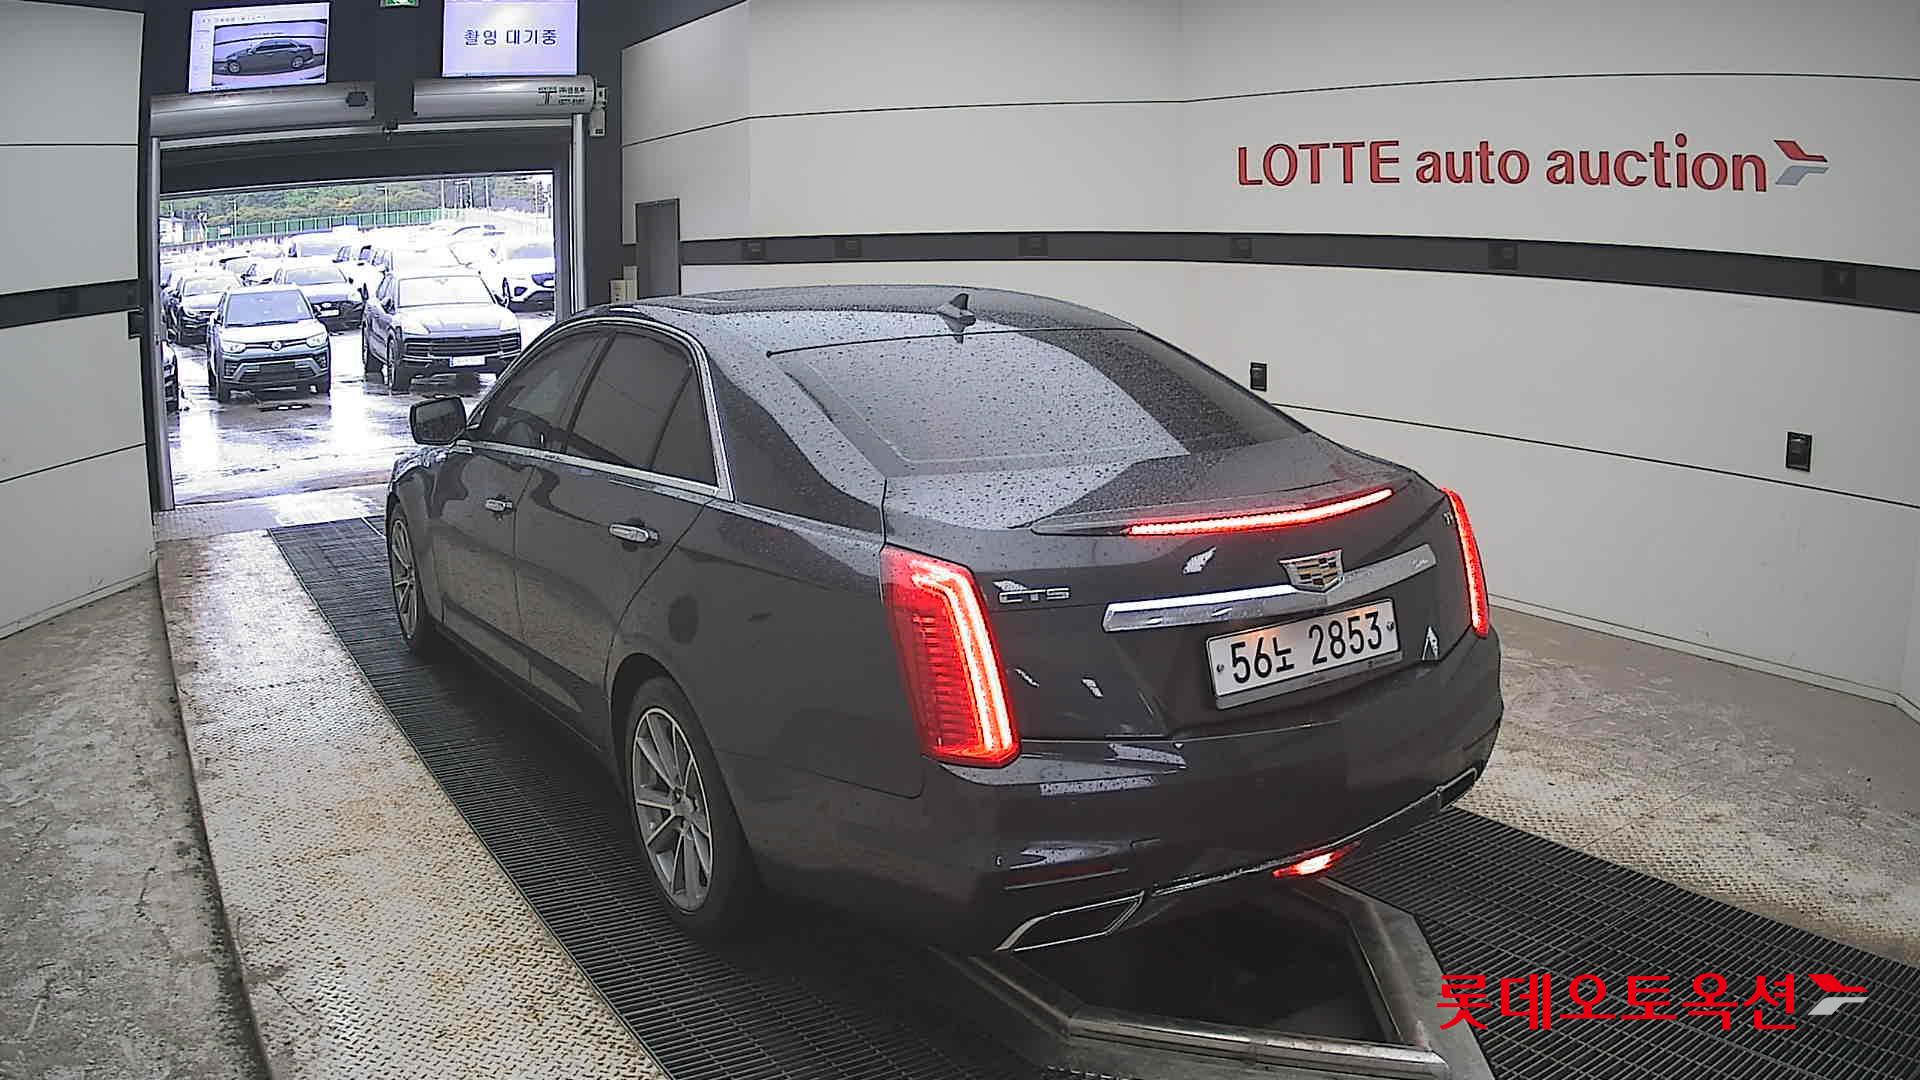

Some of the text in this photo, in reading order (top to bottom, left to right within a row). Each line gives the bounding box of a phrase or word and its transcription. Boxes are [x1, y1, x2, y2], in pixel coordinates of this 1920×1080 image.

[505, 29, 556, 46] 대기중
[1237, 132, 1767, 193] LOTTE auto auction
[999, 587, 1070, 603] CTS
[1230, 611, 1383, 684] 56노 2853
